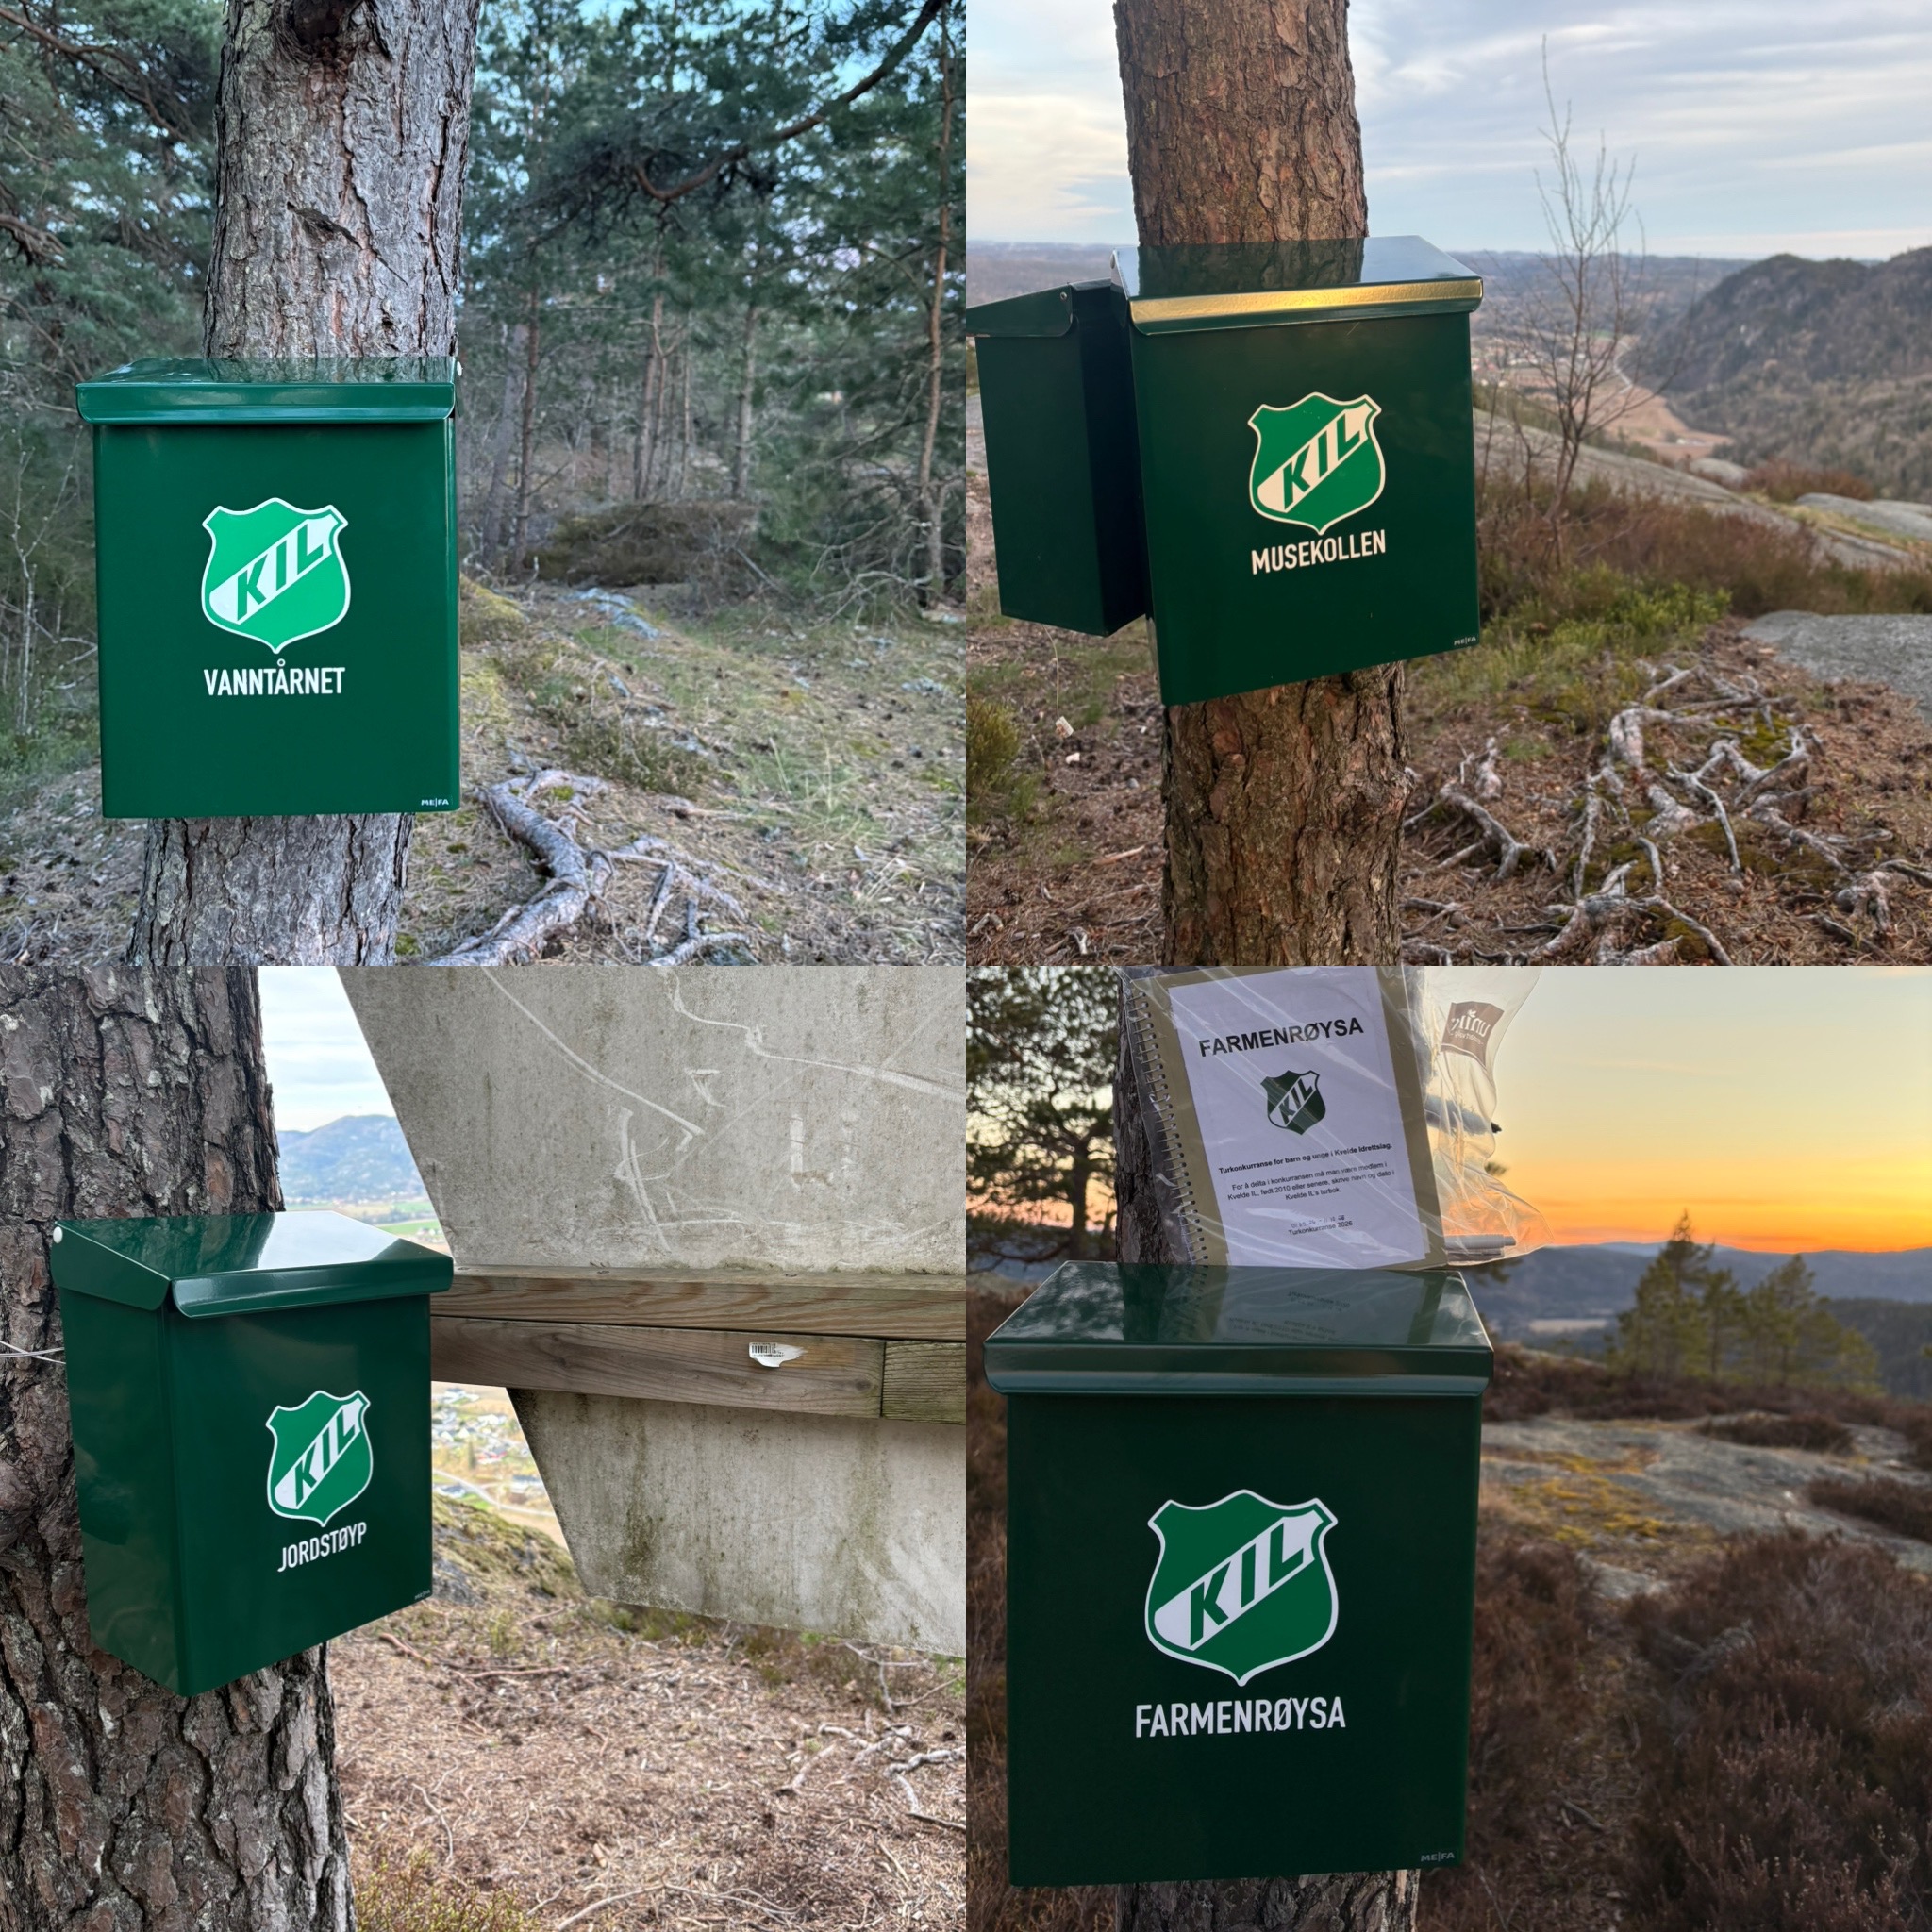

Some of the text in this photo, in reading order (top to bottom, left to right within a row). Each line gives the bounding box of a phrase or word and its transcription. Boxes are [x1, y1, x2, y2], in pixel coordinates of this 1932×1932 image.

[1282, 413, 1361, 510] KIL
[236, 525, 325, 622] KIL
[1250, 529, 1387, 575] MUSEKOLLEN
[203, 658, 346, 696] VANNTÅRNET
[1198, 1017, 1364, 1058] FARMENRØYSA
[1277, 1078, 1314, 1126] KIL
[1219, 1160, 1273, 1174] Turkonkurranse
[1285, 1156, 1301, 1164] barn
[1334, 1147, 1357, 1156] Kvelde
[1358, 1143, 1392, 1153] Idrettslag.
[1271, 1173, 1313, 1185] konkurransen
[1358, 1162, 1384, 1171] medlem
[1227, 1191, 1250, 1201] Kvelde
[1260, 1187, 1274, 1195] født
[1307, 1179, 1330, 1188] senere,
[1331, 1176, 1350, 1185] skrive
[1285, 1191, 1307, 1200] Kvelde
[1288, 1224, 1336, 1236] Turkonkurranse
[294, 1407, 356, 1507] KIL
[276, 1522, 368, 1573] JORDSTØYP
[1189, 1522, 1305, 1648] KIL
[1135, 1696, 1347, 1739] FARMENRØYSA
